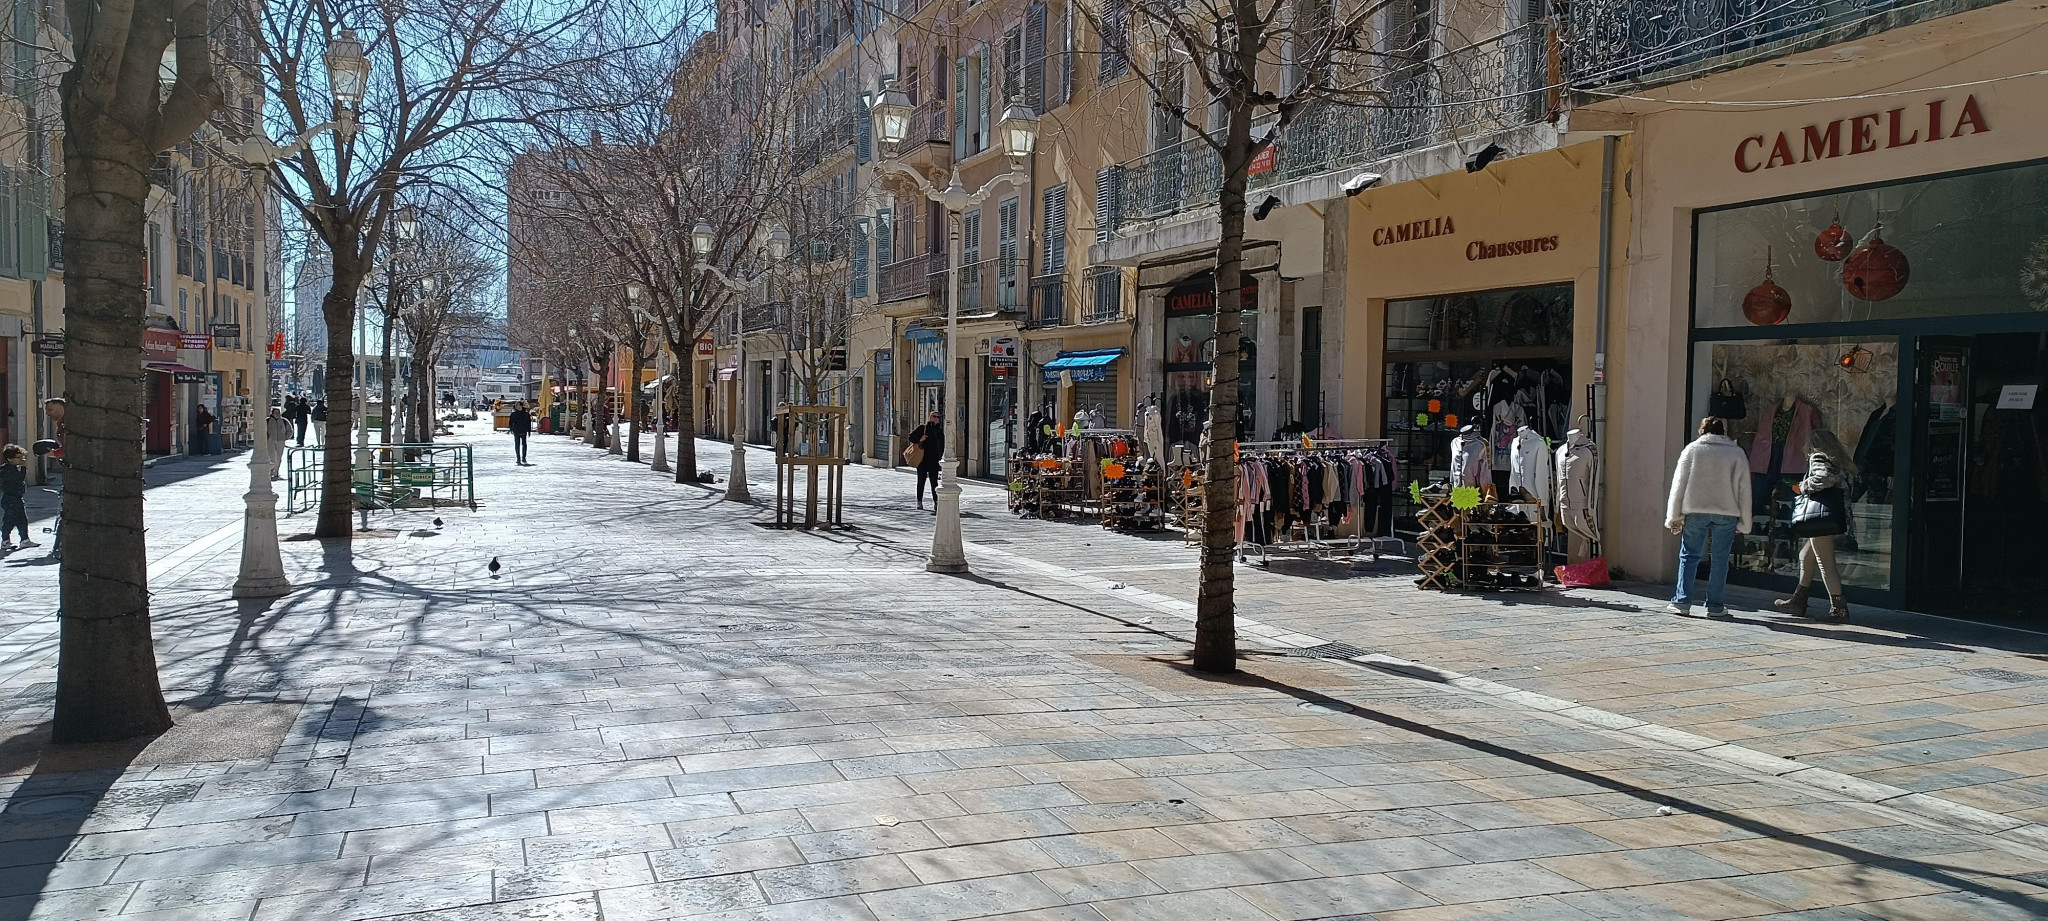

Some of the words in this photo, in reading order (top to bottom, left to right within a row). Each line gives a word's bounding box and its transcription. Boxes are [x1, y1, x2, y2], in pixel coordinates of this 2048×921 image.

[1734, 93, 1991, 174] CAMELIA
[1372, 215, 1455, 247] CAMELIA
[1465, 234, 1559, 262] Chaussures
[1171, 292, 1213, 310] CAMELIA
[917, 340, 944, 374] FANTASIA
